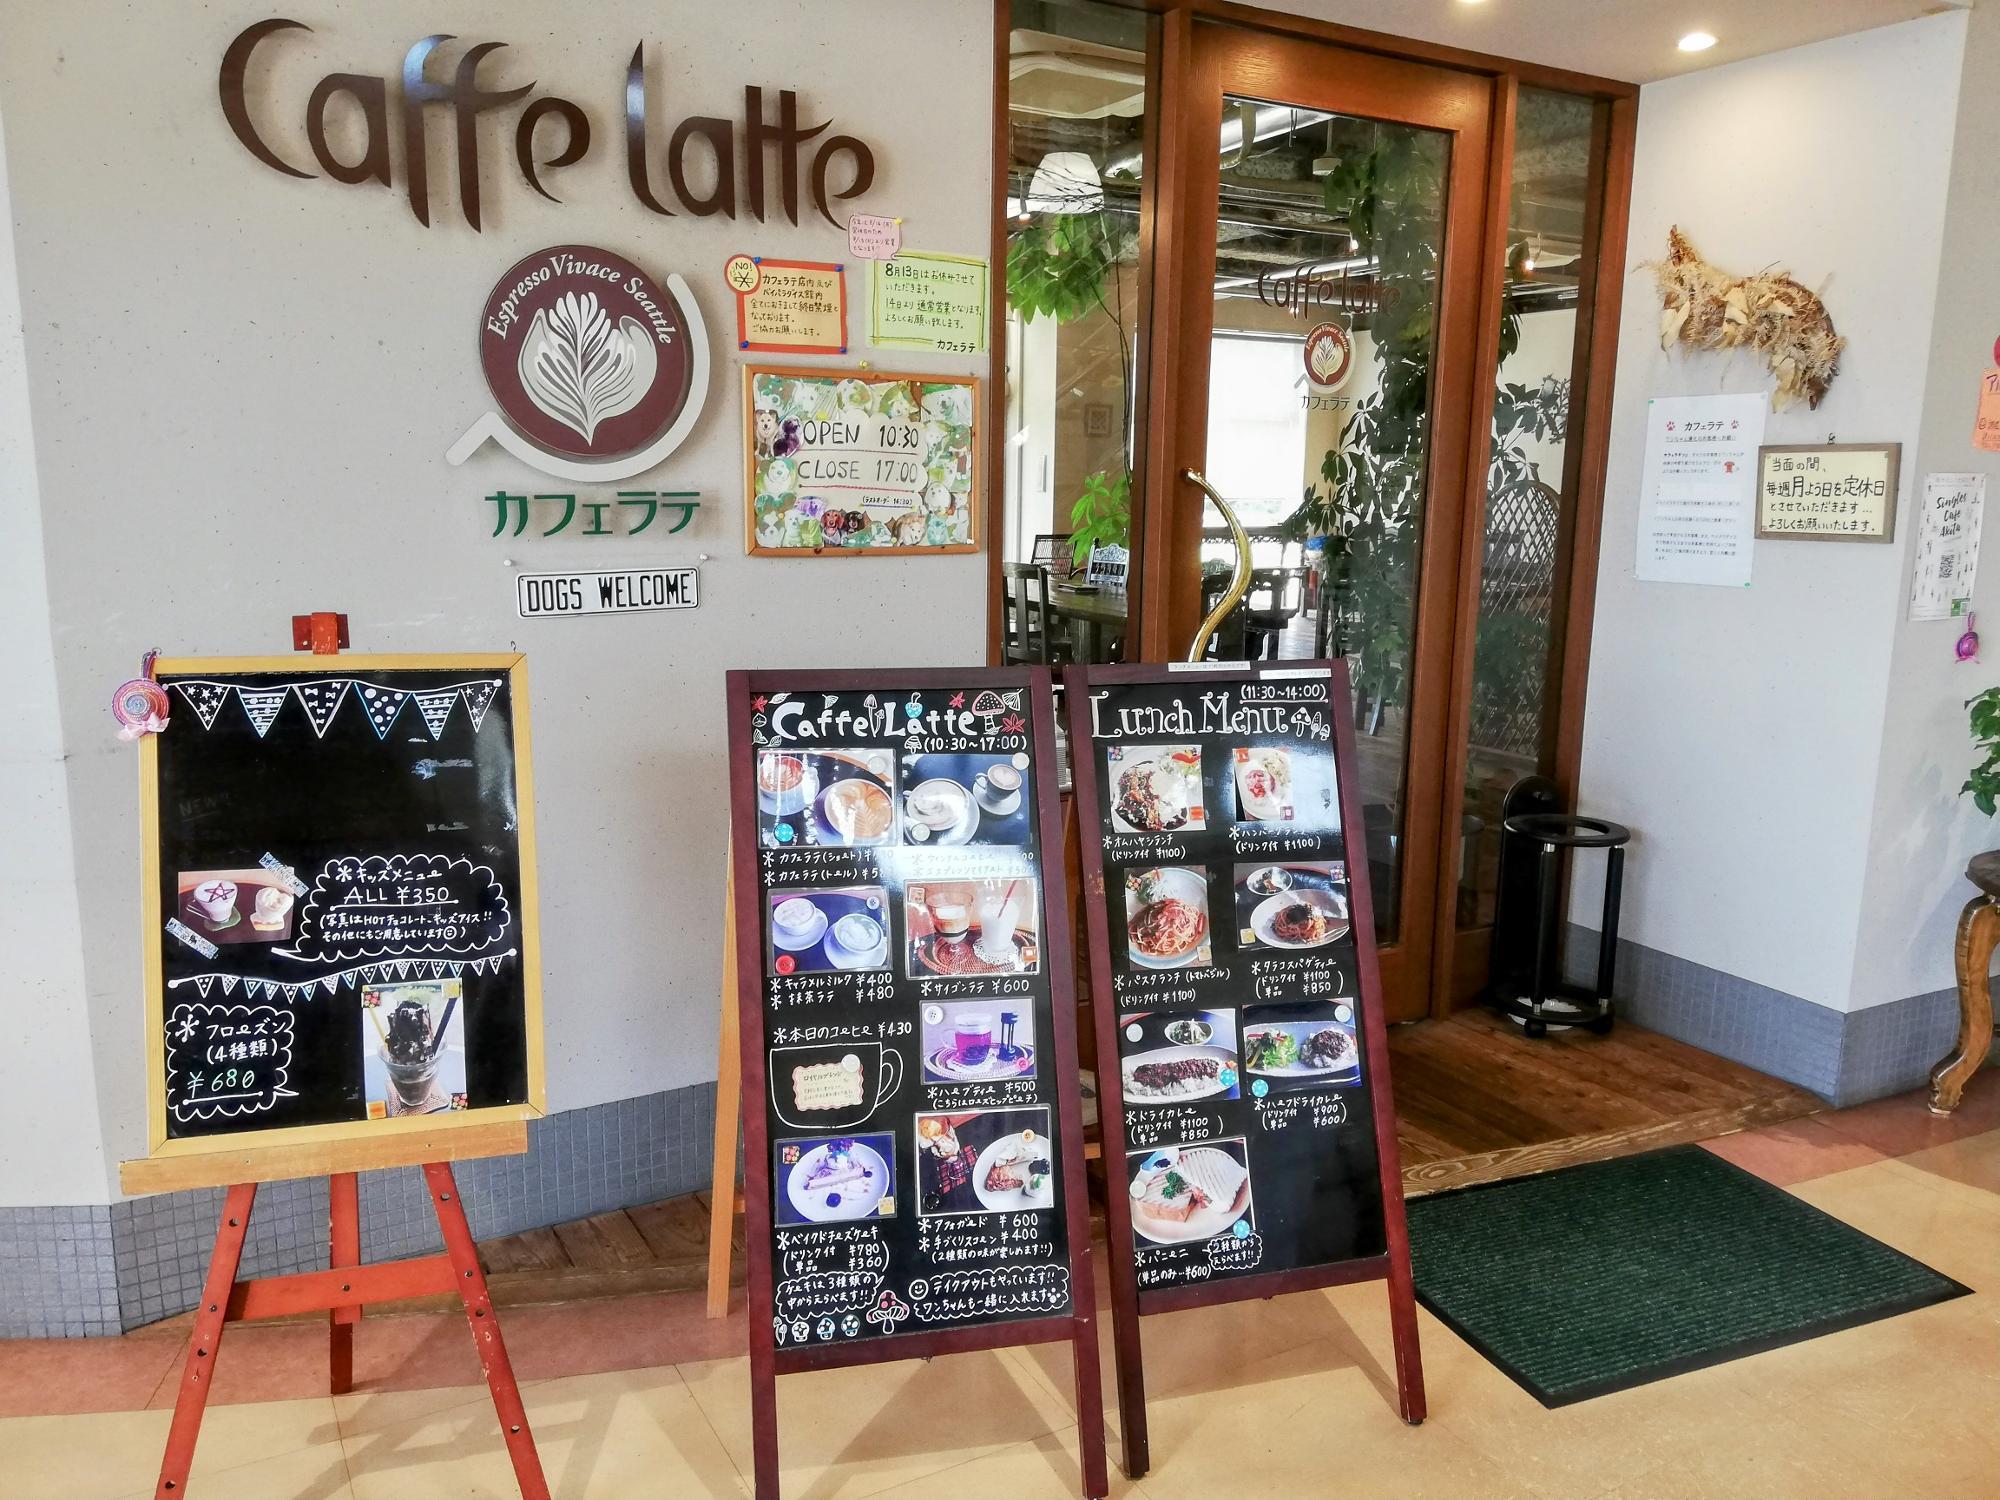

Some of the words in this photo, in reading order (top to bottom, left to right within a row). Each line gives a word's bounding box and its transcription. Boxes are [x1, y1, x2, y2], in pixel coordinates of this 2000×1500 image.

[219, 17, 592, 233] Caffe
[735, 262, 752, 271] NO!
[487, 266, 551, 340] Espresso
[549, 253, 621, 283] Vivace
[623, 276, 677, 345] Seattle
[937, 340, 976, 353] カフェラテ
[1300, 395, 1350, 411] カフェラテ
[803, 420, 860, 445] OPEN
[879, 425, 919, 449] 10:30
[1684, 421, 1724, 431] カフェラテ
[798, 461, 861, 479] CLOSE
[876, 460, 918, 484] 17:00
[1766, 475, 1885, 497] 毎週月よう日を定休日
[485, 491, 700, 537] カフェラテ
[527, 578, 582, 611] DOGS
[598, 573, 691, 608] WELCOME
[771, 701, 869, 741] Caffe
[884, 701, 977, 737] Latte
[1089, 691, 1195, 738] Lunch
[1199, 691, 1288, 735] Menu
[356, 865, 443, 883] キッズメニュー
[344, 886, 388, 904] ALL
[396, 886, 449, 905] ¥350
[785, 975, 852, 990] キャラメルミルク
[856, 972, 893, 987] ¥400
[934, 980, 985, 996] サイゴンラテ
[991, 979, 1030, 994] ¥600
[1129, 971, 1180, 987] パスタランチ
[788, 990, 834, 1005] 抹茶ラテ
[856, 986, 894, 1003] ¥480
[1266, 986, 1282, 998] 単品
[1303, 982, 1331, 996] ¥850
[206, 1017, 286, 1040] フローズン
[789, 1025, 873, 1043] 本日のコーヒー
[878, 1021, 912, 1039] ¥430
[207, 1038, 277, 1064] (4種類)
[187, 1068, 255, 1098] ¥680
[940, 1083, 996, 1097] ハーブティー
[1004, 1081, 1036, 1093] ¥500
[1267, 1094, 1342, 1108] ハーフドライカレー
[1314, 1104, 1338, 1116] ¥900
[1140, 1108, 1197, 1121] ドライカレー
[1271, 1118, 1287, 1130] 単品
[1314, 1115, 1340, 1128] ¥600
[1140, 1132, 1158, 1146] 単品
[1181, 1129, 1209, 1141] ¥850
[791, 1225, 879, 1246] ベイクドチーズケーキ
[934, 1234, 998, 1251] 手づくりスコーン
[1001, 1227, 1038, 1245] ¥400
[849, 1243, 880, 1257] ¥780
[1149, 1249, 1189, 1263] パニーニ
[795, 1260, 818, 1274] 単品
[849, 1256, 882, 1271] ¥360
